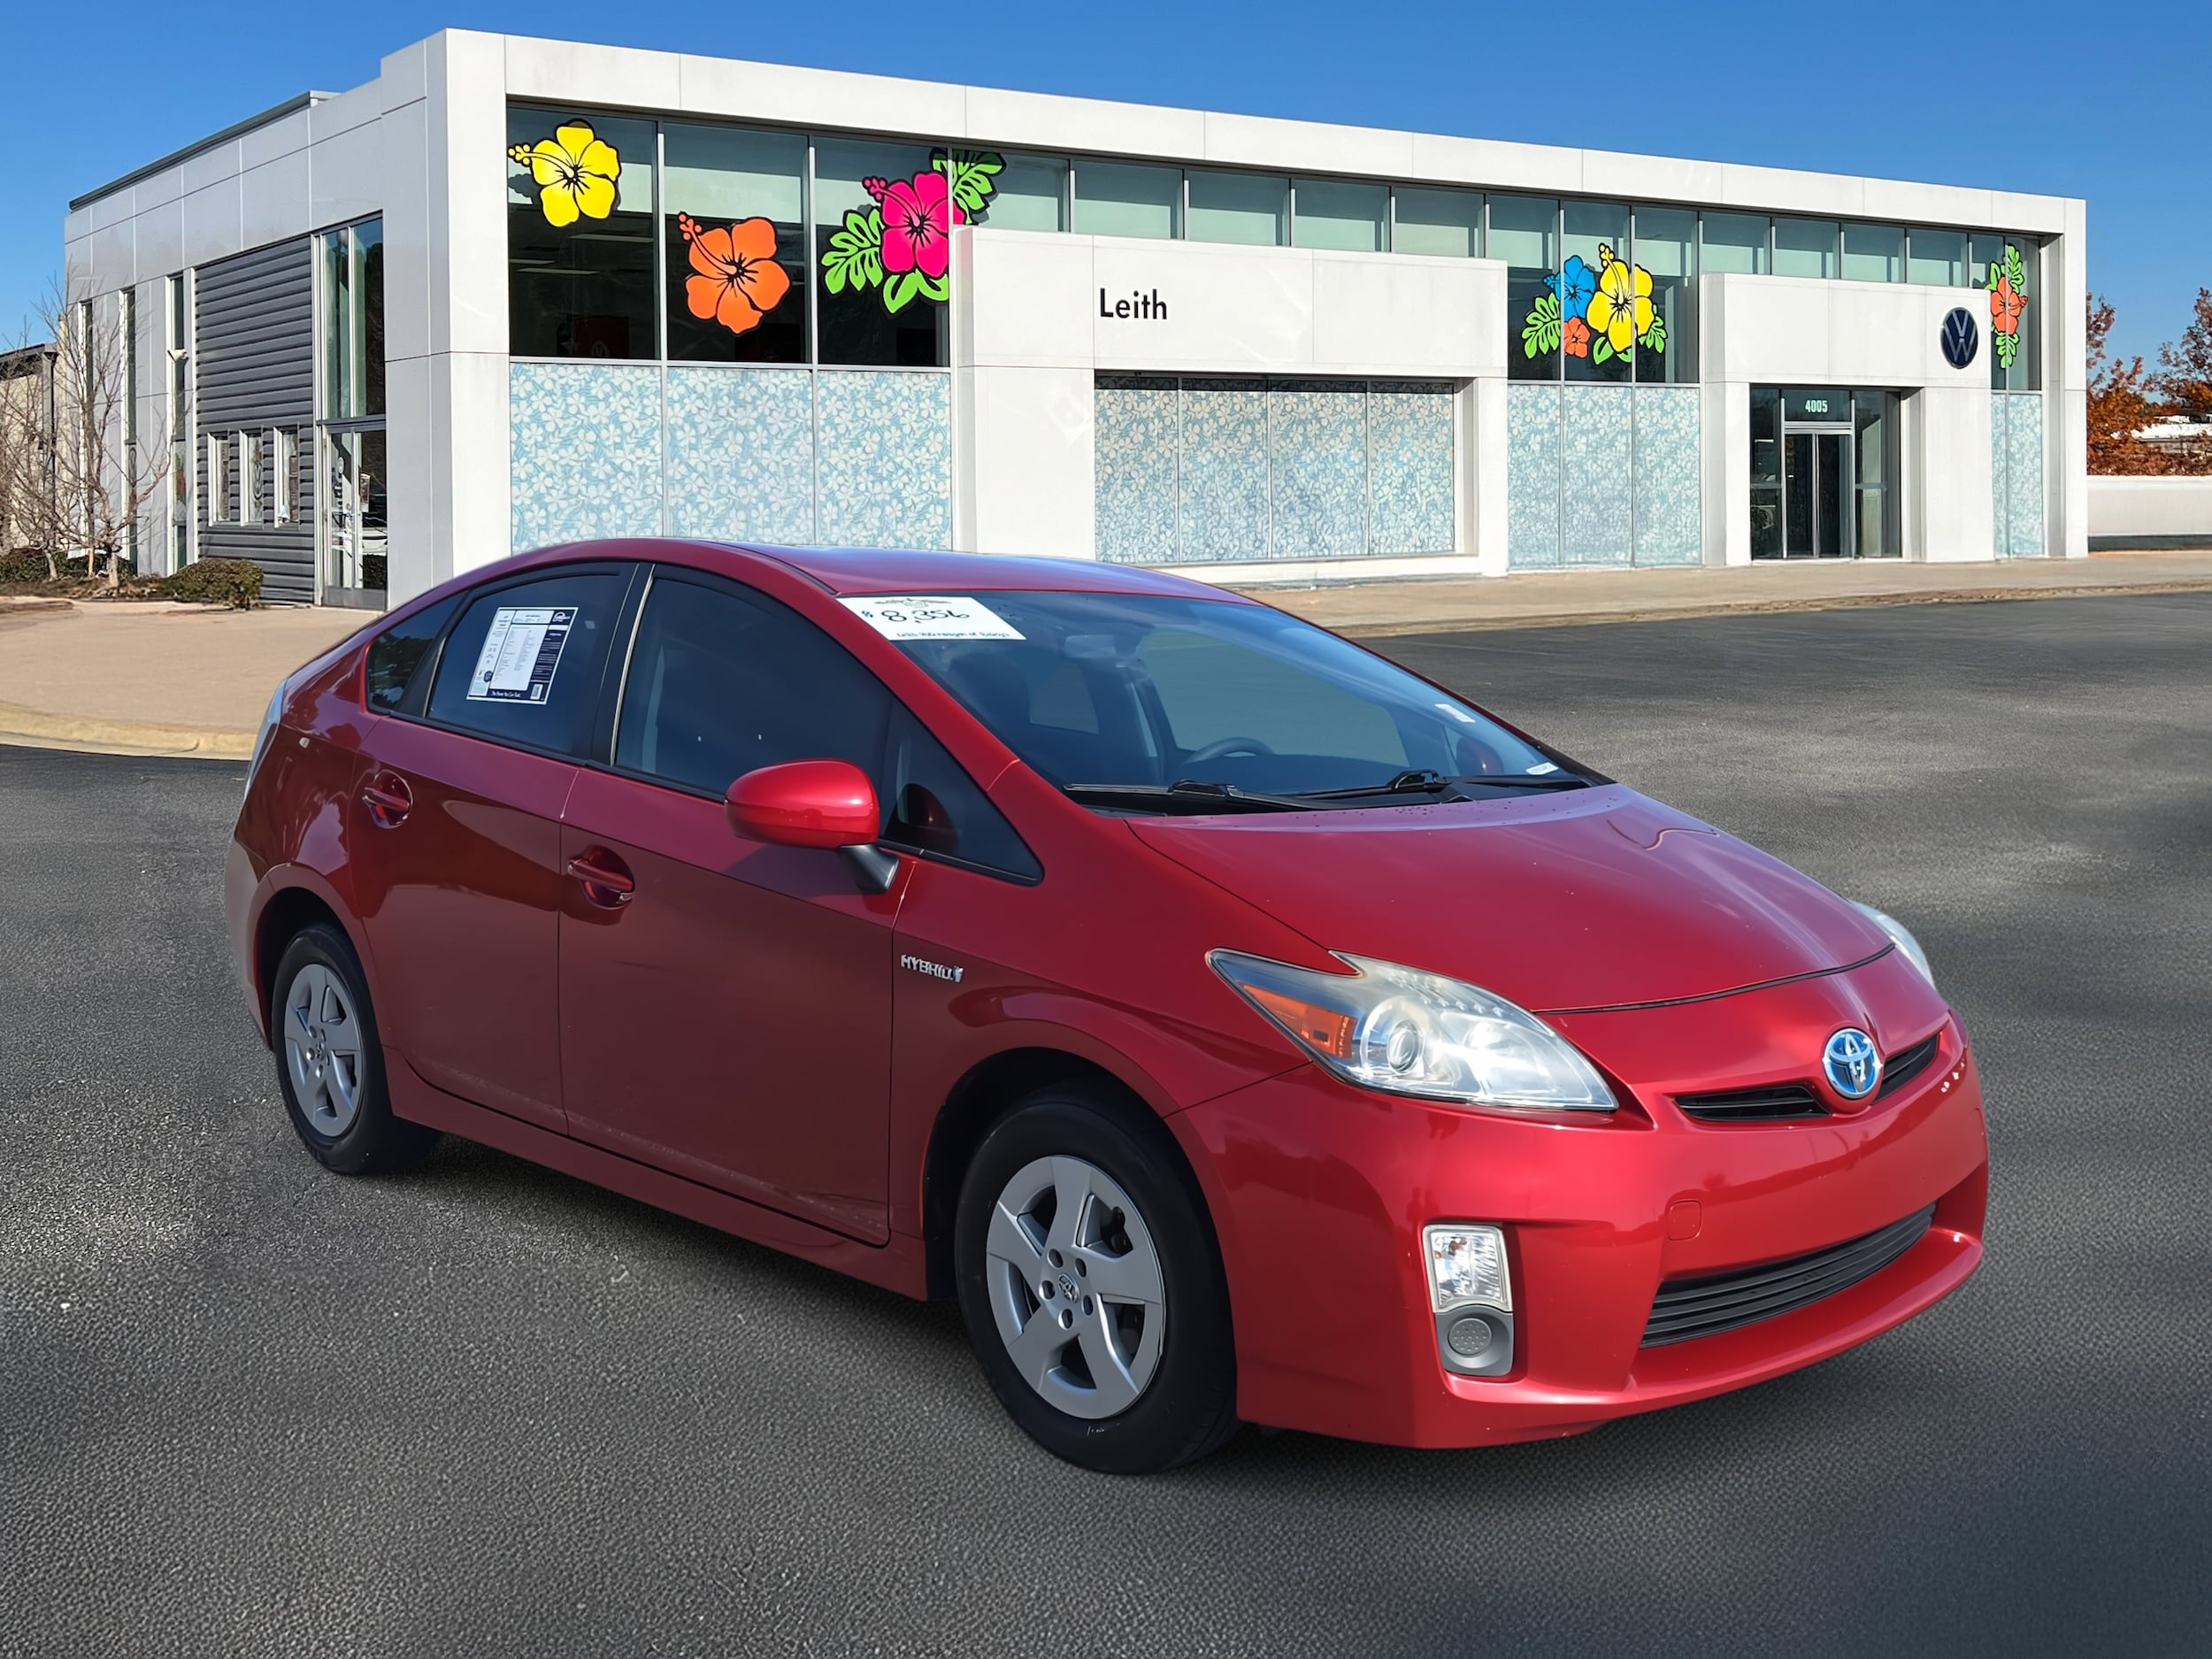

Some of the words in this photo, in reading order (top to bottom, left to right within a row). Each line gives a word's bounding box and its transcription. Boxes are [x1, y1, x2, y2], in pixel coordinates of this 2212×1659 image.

[1100, 288, 1167, 319] Leith
[1805, 399, 1828, 413] 4005
[900, 954, 954, 980] HYBRID
